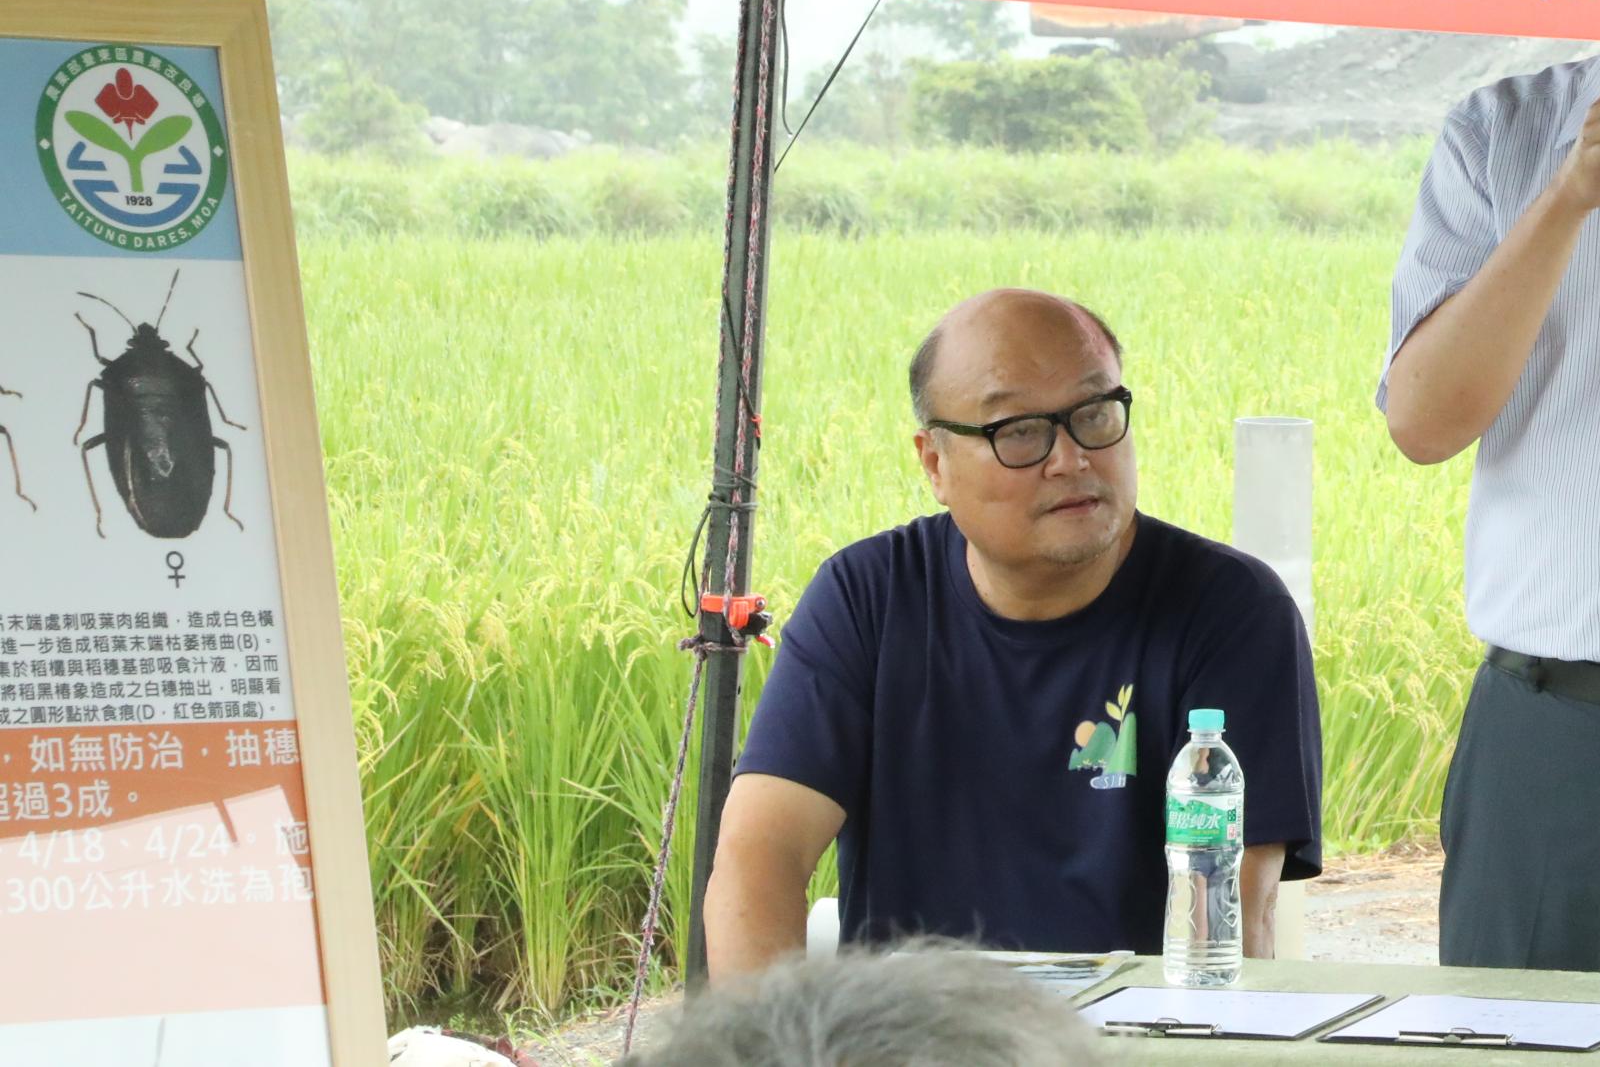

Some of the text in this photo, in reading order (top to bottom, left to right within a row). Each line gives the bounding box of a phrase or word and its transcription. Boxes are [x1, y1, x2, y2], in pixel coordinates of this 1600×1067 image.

[61, 192, 128, 245] TAITUNG
[191, 196, 218, 228] MOA
[125, 195, 153, 207] 1928
[0, 780, 139, 822] 過3成。
